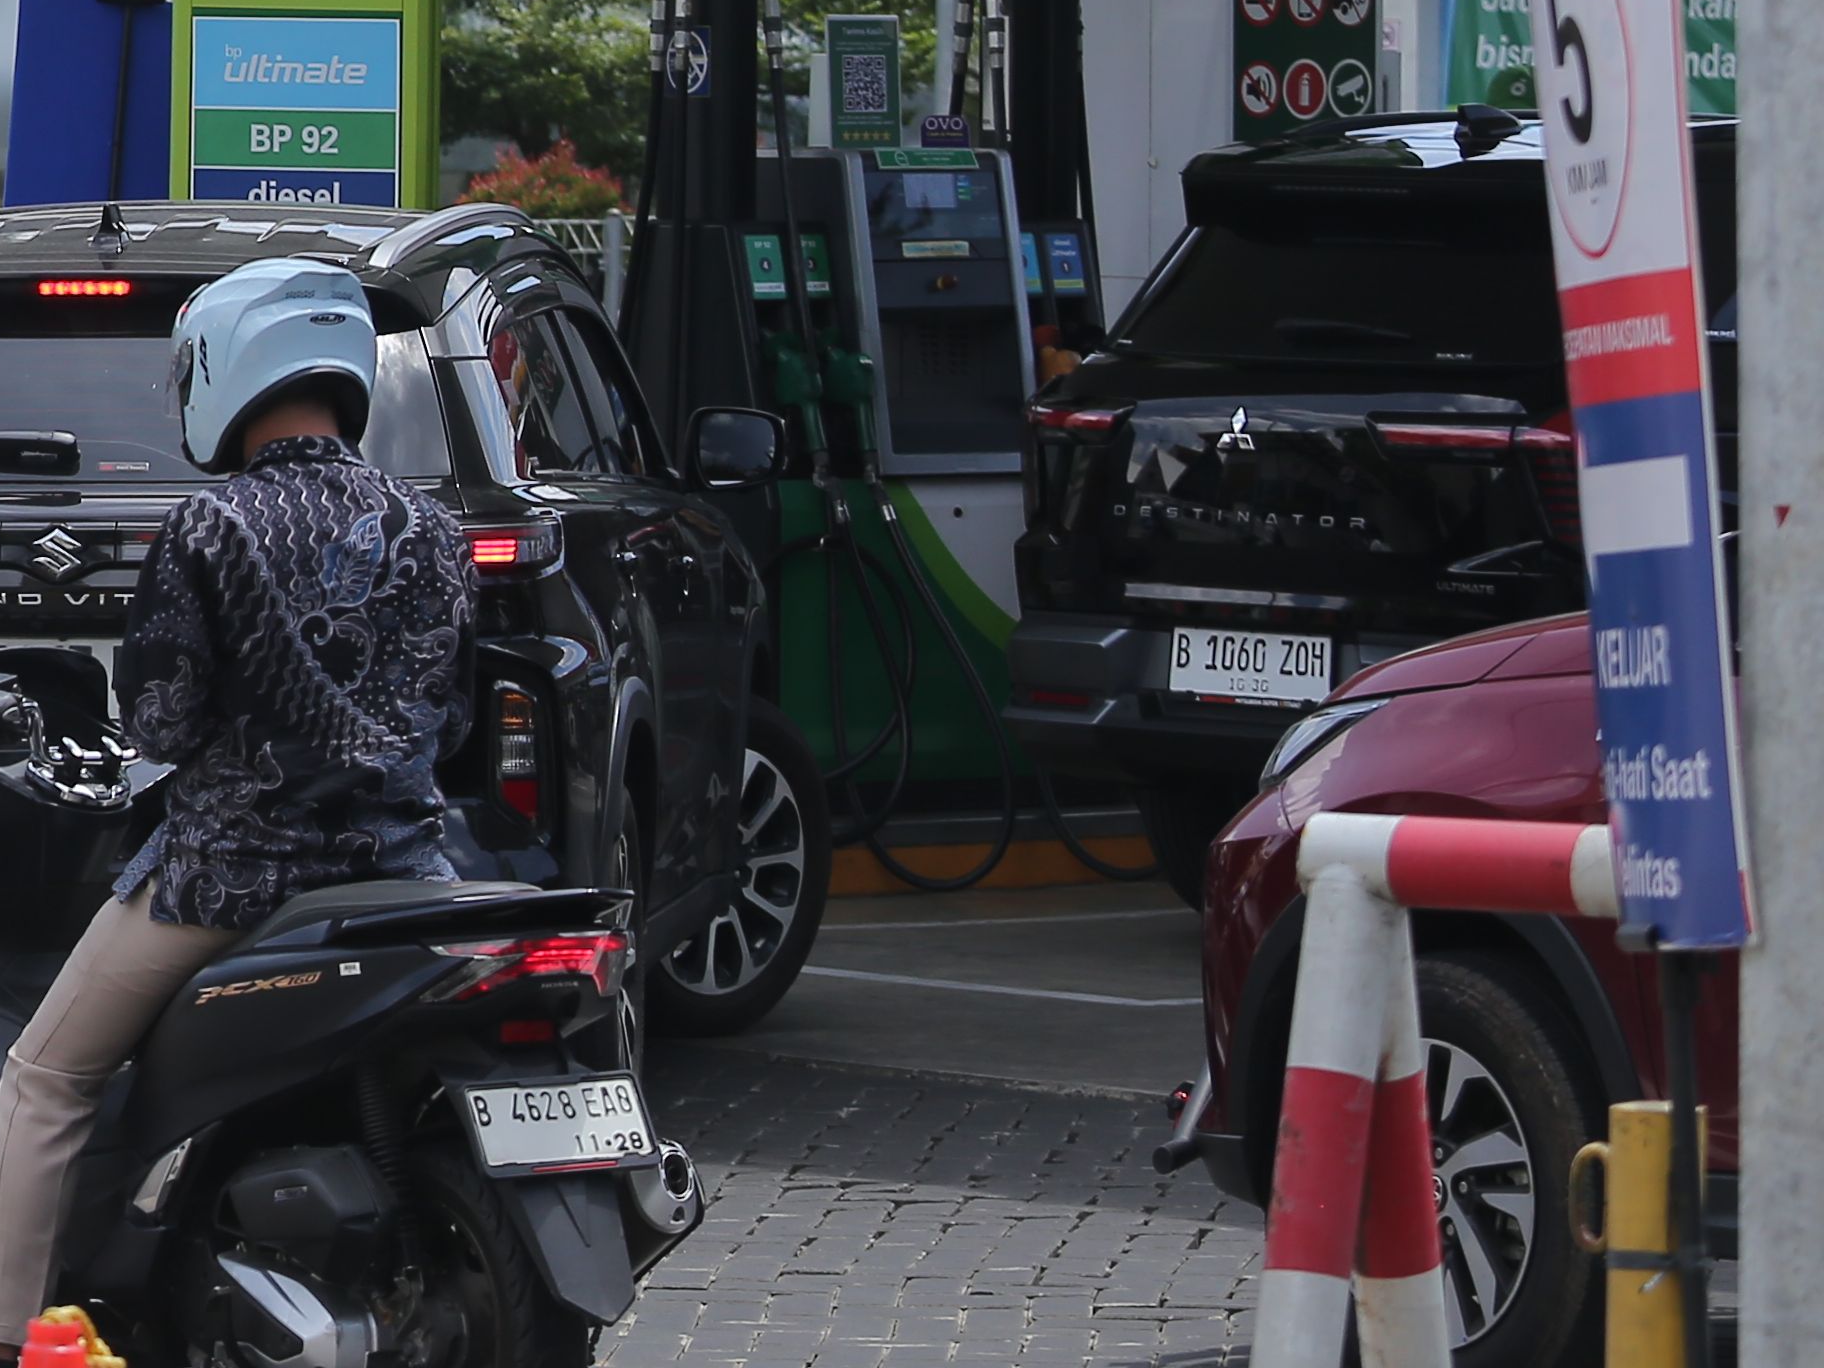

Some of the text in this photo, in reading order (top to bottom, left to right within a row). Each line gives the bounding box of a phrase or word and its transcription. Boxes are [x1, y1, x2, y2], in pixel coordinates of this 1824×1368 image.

[225, 44, 242, 60] bp
[224, 54, 367, 85] ultimate
[925, 117, 963, 131] OVO
[250, 123, 339, 154] BP 92
[247, 180, 341, 205] diesel
[1114, 504, 1366, 529] DESTINATOR
[64, 593, 135, 606] VIT
[1437, 581, 1495, 595] ULTIMATE
[1177, 633, 1325, 678] B 1060 ZOH
[1596, 625, 1671, 688] KELUAR
[1652, 744, 1711, 800] Saat
[1620, 842, 1682, 898] elintas
[284, 971, 322, 987] 160
[473, 1095, 492, 1126] B
[512, 1089, 577, 1122] 4628
